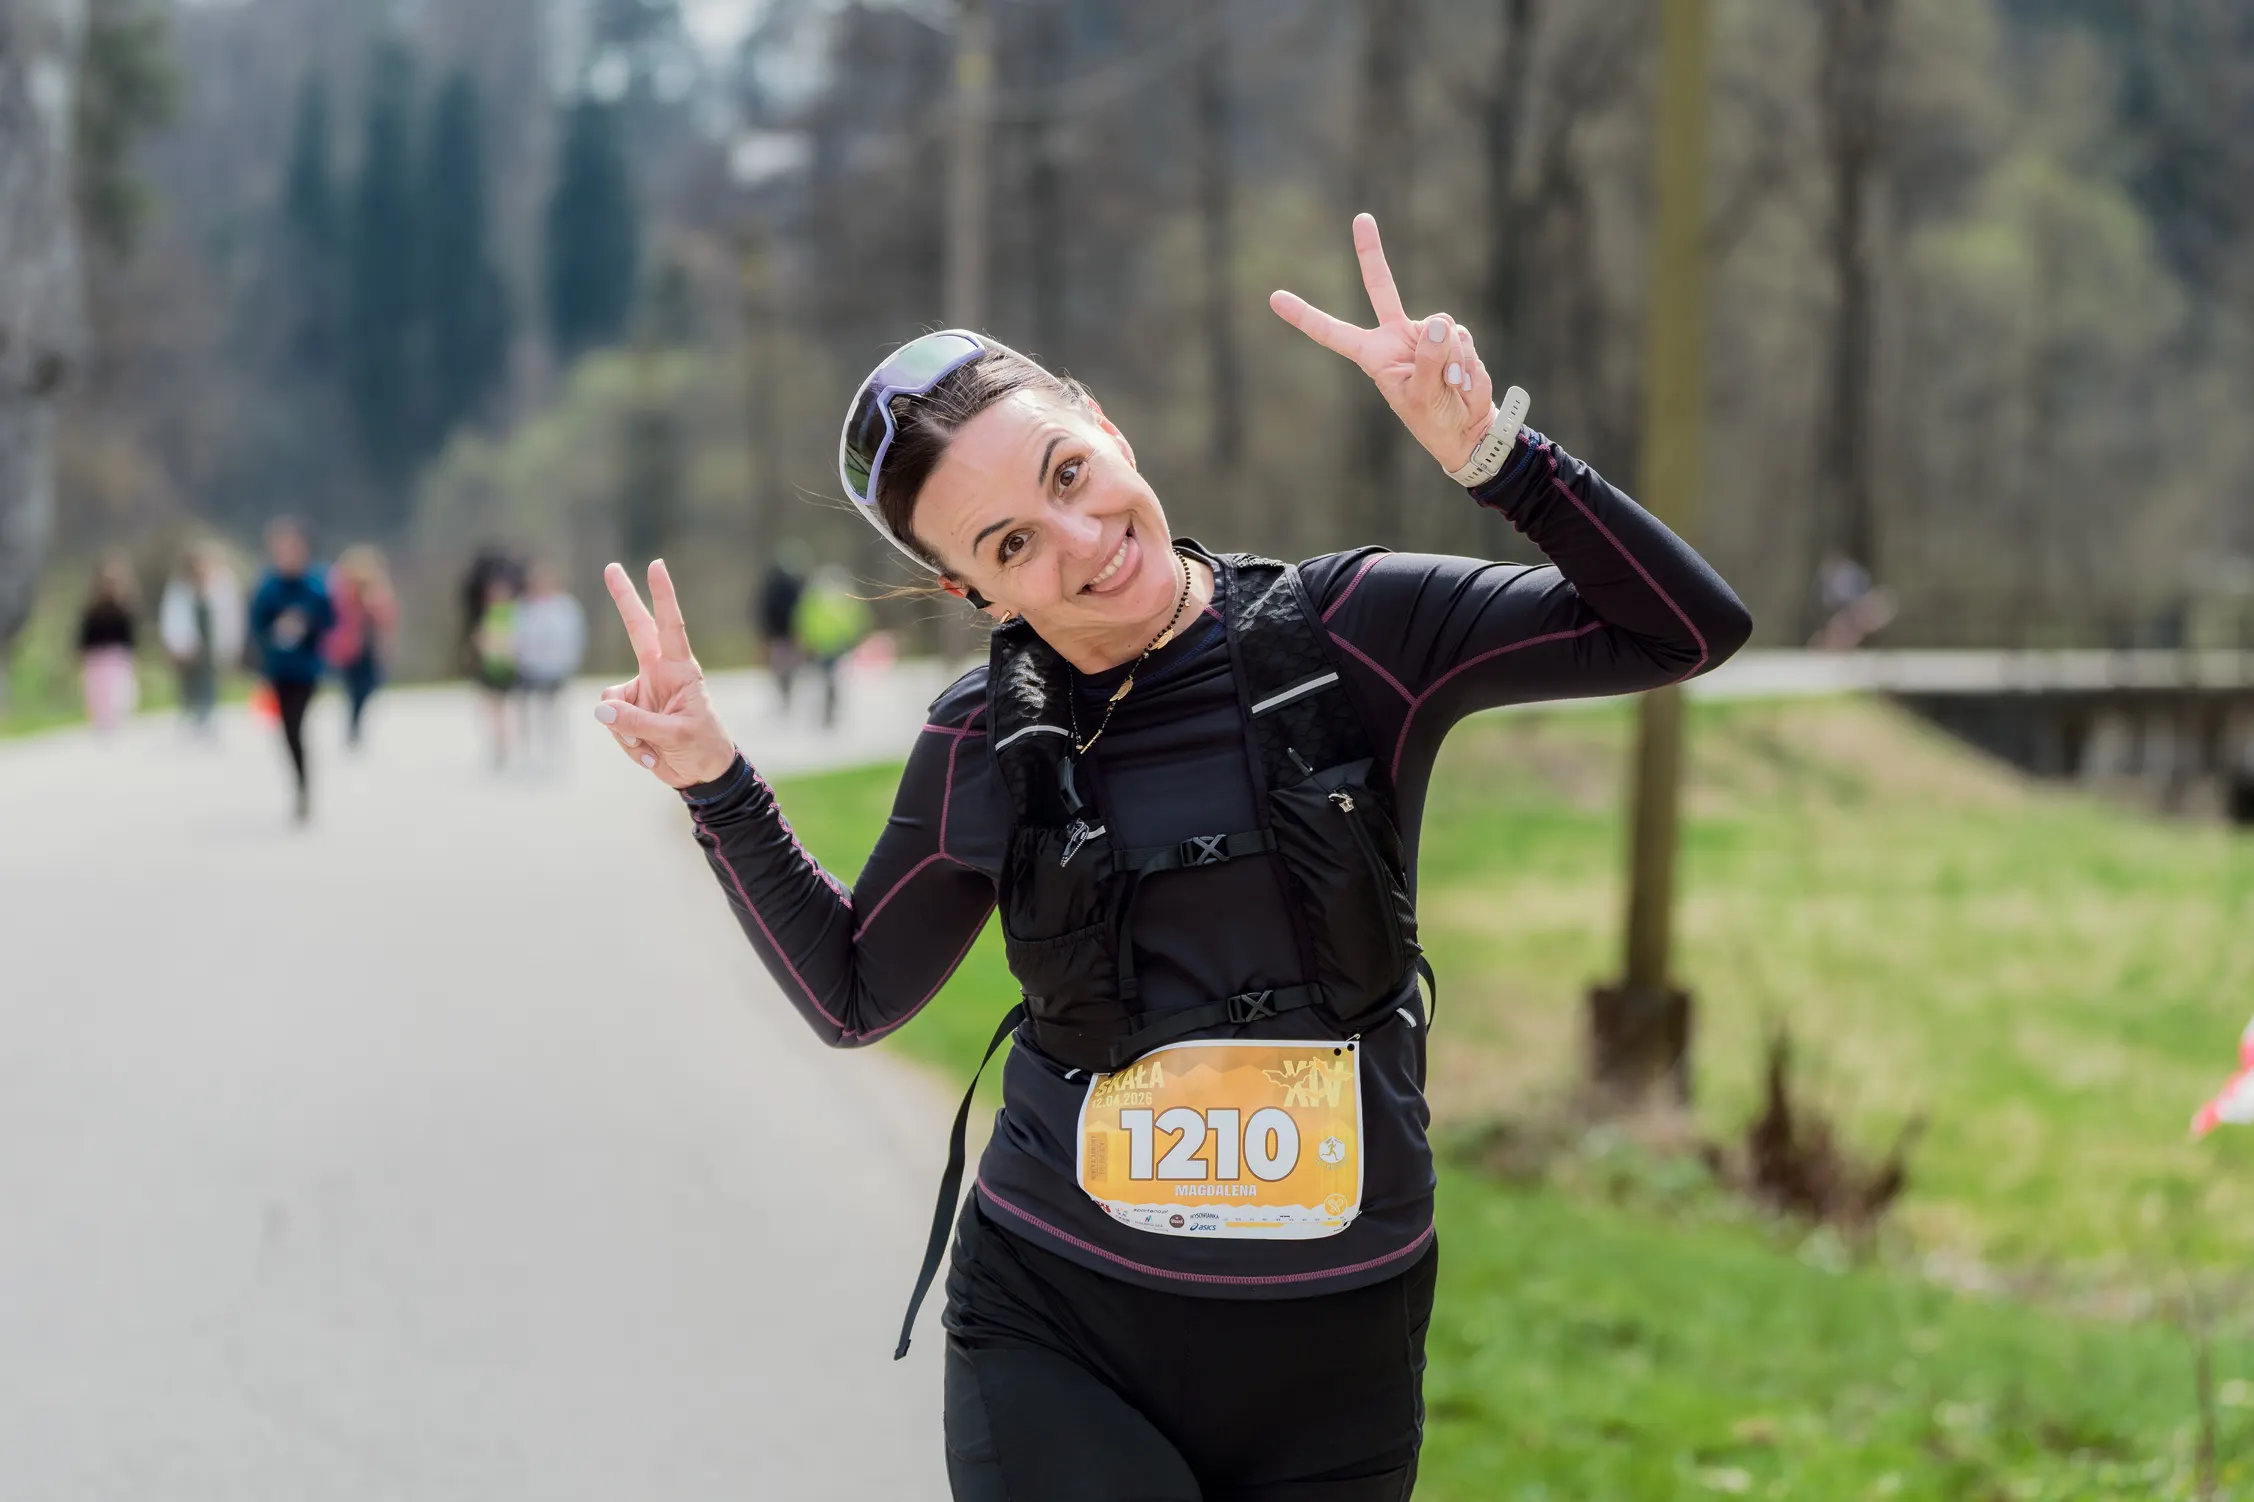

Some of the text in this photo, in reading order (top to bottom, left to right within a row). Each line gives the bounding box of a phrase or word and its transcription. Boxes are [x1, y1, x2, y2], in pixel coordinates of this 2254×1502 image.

[1095, 1062, 1165, 1097] SKAŁA
[1092, 1092, 1153, 1109] 12.04.2026
[1119, 1106, 1300, 1182] 1210
[1175, 1184, 1257, 1197] MAGDALENA
